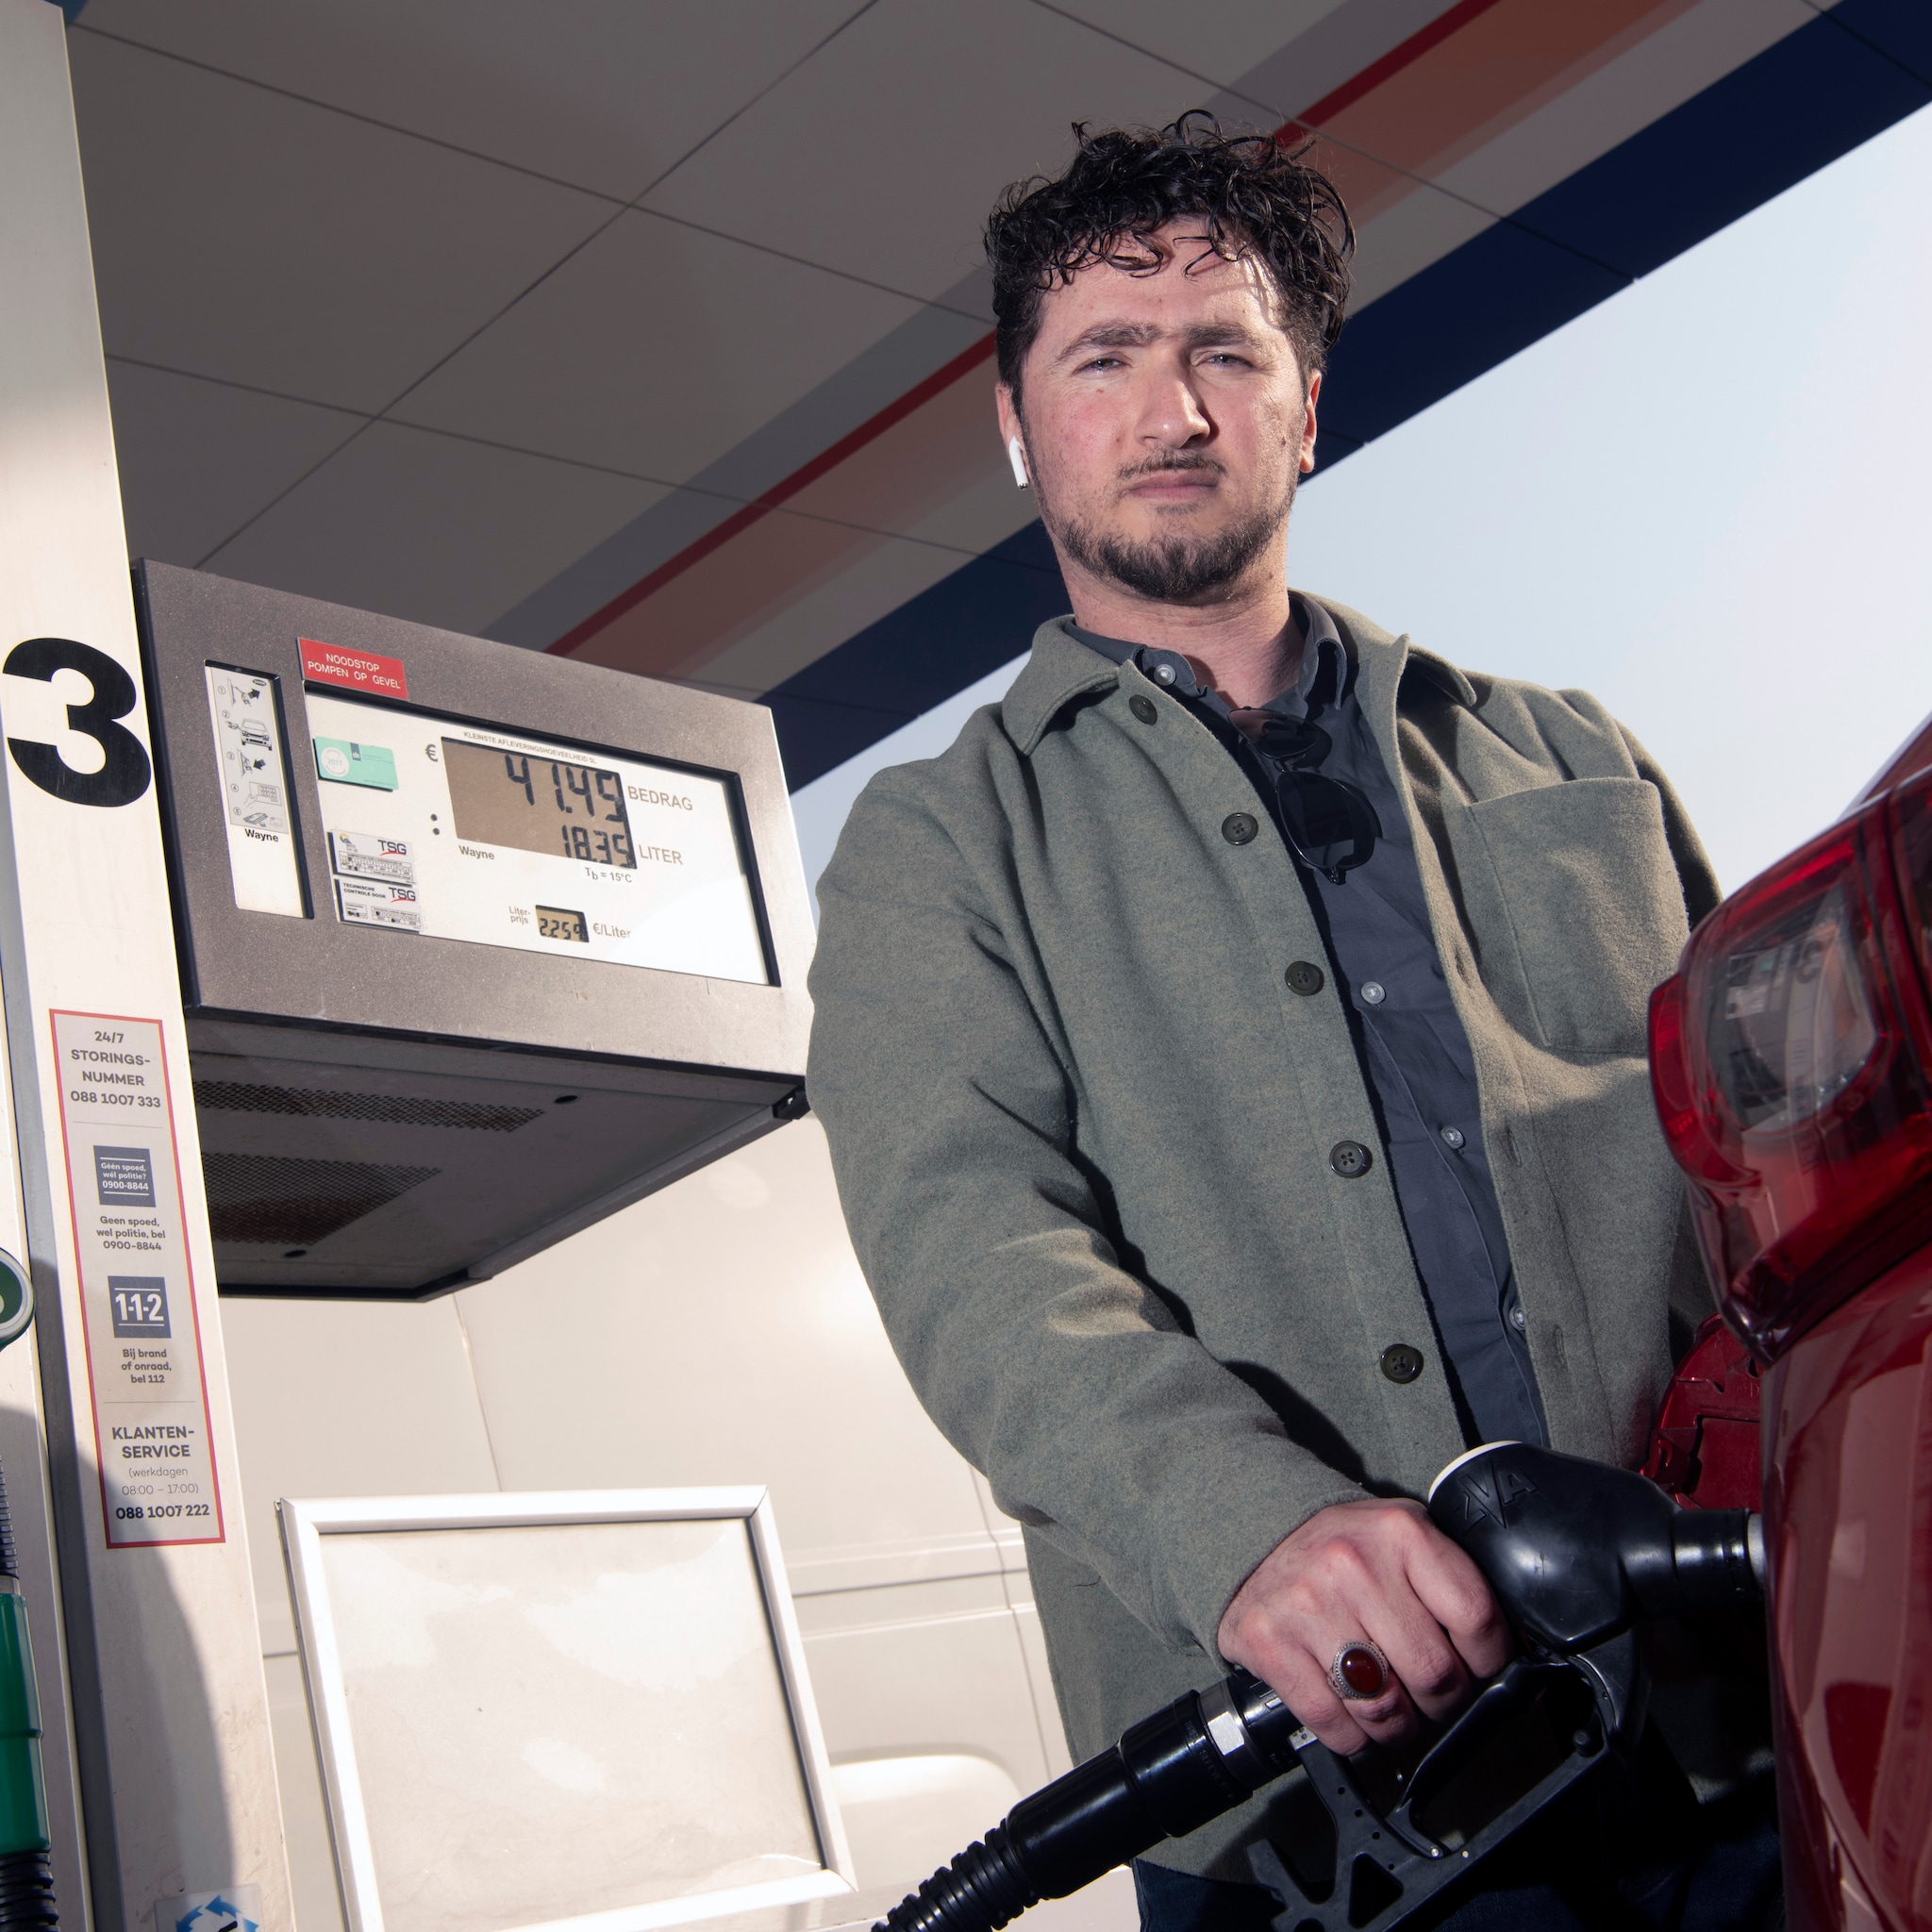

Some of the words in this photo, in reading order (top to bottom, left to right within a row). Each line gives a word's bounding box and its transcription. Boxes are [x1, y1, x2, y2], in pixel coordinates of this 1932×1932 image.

[325, 653, 380, 672] NOODSTOP
[308, 660, 349, 677] POMPEN
[354, 671, 368, 681] OP
[372, 675, 401, 690] GEVEL
[2, 637, 152, 808] 3
[463, 731, 497, 743] KLEINSTE
[425, 743, 439, 762] €
[627, 785, 692, 811] BEDRAG
[244, 828, 279, 842] Wayne
[377, 840, 407, 856] TSG
[458, 844, 495, 860] Wayne
[639, 844, 683, 866] LITER
[609, 872, 632, 884] 15°C
[342, 883, 375, 892] TECHNISCHE
[343, 888, 371, 896] CONTROLE
[388, 887, 416, 902] TSG
[508, 906, 531, 916] Liter-
[510, 915, 529, 925] prijs
[592, 923, 631, 939] €/Liter
[94, 1031, 124, 1043] 24/7
[71, 1049, 151, 1066] STORINGS-
[82, 1071, 145, 1086] NUMMER
[70, 1091, 98, 1103] 088
[101, 1093, 135, 1107] 1007
[138, 1096, 161, 1108] 333
[101, 1162, 121, 1172] Géén
[122, 1164, 147, 1173] spoed,
[103, 1171, 117, 1179] wél
[118, 1172, 147, 1181] politie?
[102, 1180, 149, 1191] 0900-8844
[100, 1215, 125, 1224] Geen
[127, 1217, 159, 1228] spoed,
[96, 1228, 113, 1237] wel
[116, 1228, 150, 1240] politie,
[151, 1230, 166, 1239] bel
[103, 1241, 162, 1251] 0900-8844
[123, 1349, 136, 1360] Bij
[138, 1349, 167, 1357] brand
[121, 1362, 132, 1371] of
[134, 1362, 172, 1372] onraad,
[130, 1374, 146, 1383] bel
[148, 1374, 165, 1383] 112
[112, 1426, 194, 1440] KLANTEN-
[122, 1444, 191, 1458] SERVICE
[128, 1466, 189, 1478] (werkdagen
[122, 1485, 154, 1495] 08:00
[167, 1483, 199, 1494] 17:00)
[116, 1507, 144, 1520] 088
[147, 1506, 183, 1518] 1007
[185, 1504, 209, 1517] 222
